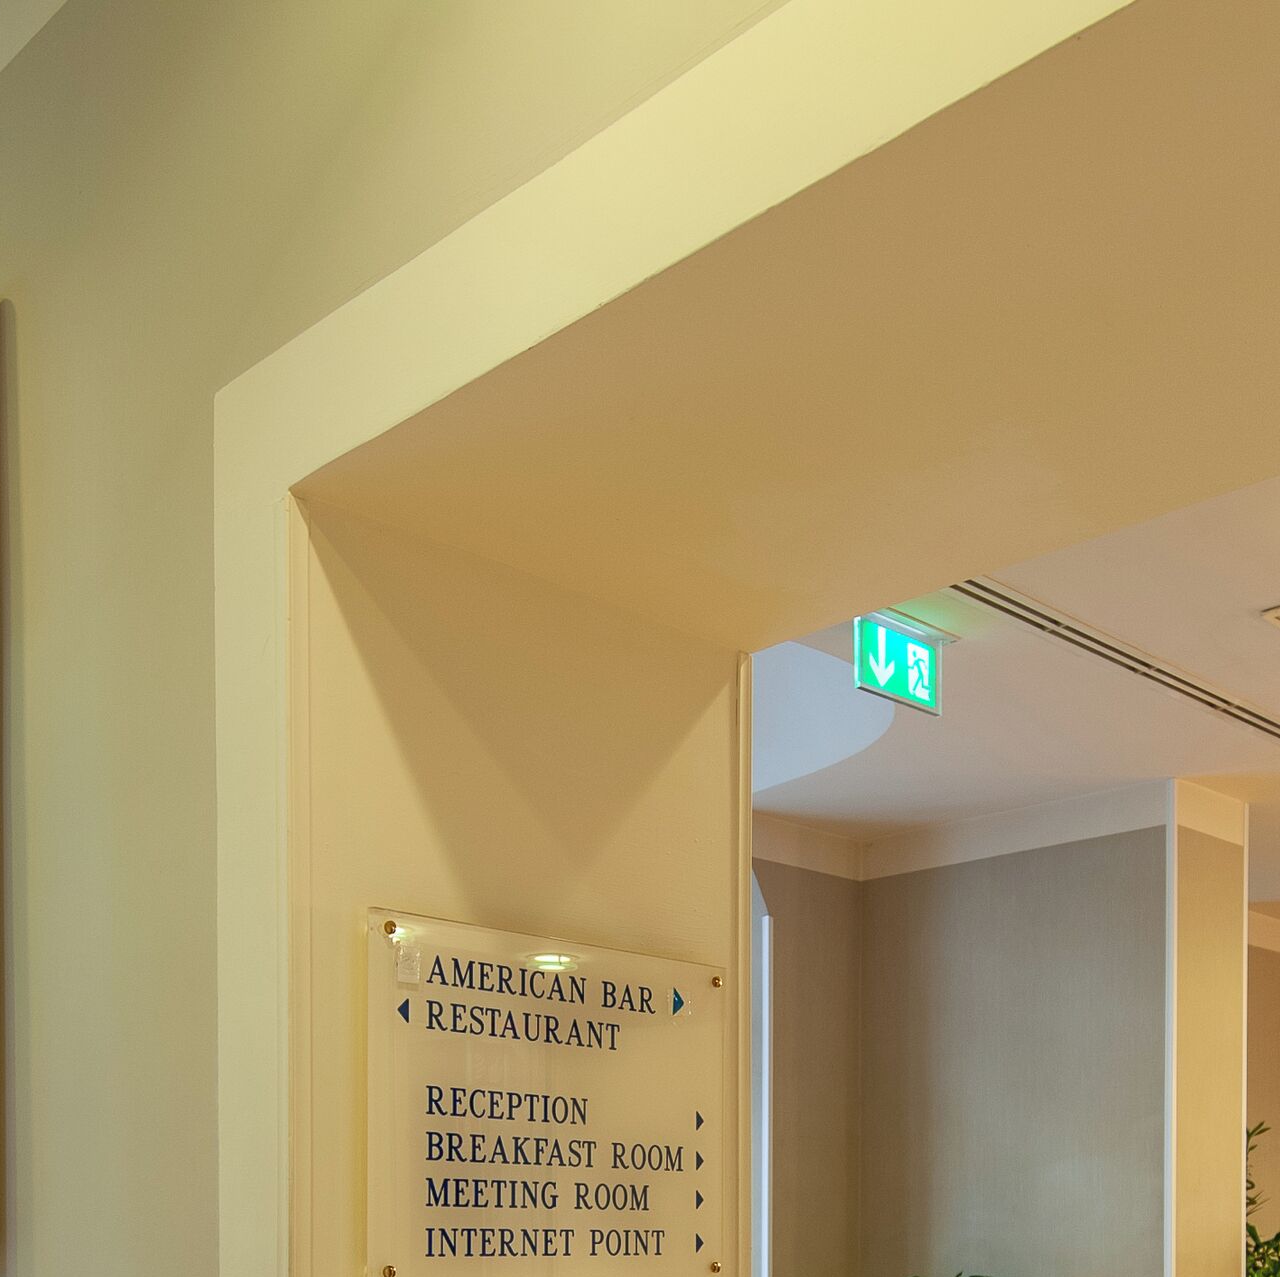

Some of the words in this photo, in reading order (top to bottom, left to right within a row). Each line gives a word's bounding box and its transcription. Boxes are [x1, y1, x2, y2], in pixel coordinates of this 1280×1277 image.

[426, 955, 586, 1004] AMERICAN
[601, 980, 656, 1014] BAR
[426, 1000, 620, 1050] RESTAURANT
[426, 1085, 588, 1125] RECEPTION
[426, 1131, 596, 1168] BREAKFAST
[611, 1142, 684, 1172] ROOM
[426, 1178, 559, 1209] MEETING
[574, 1182, 649, 1211] ROOM
[425, 1228, 574, 1257] INTERNET
[589, 1229, 665, 1256] POINT
